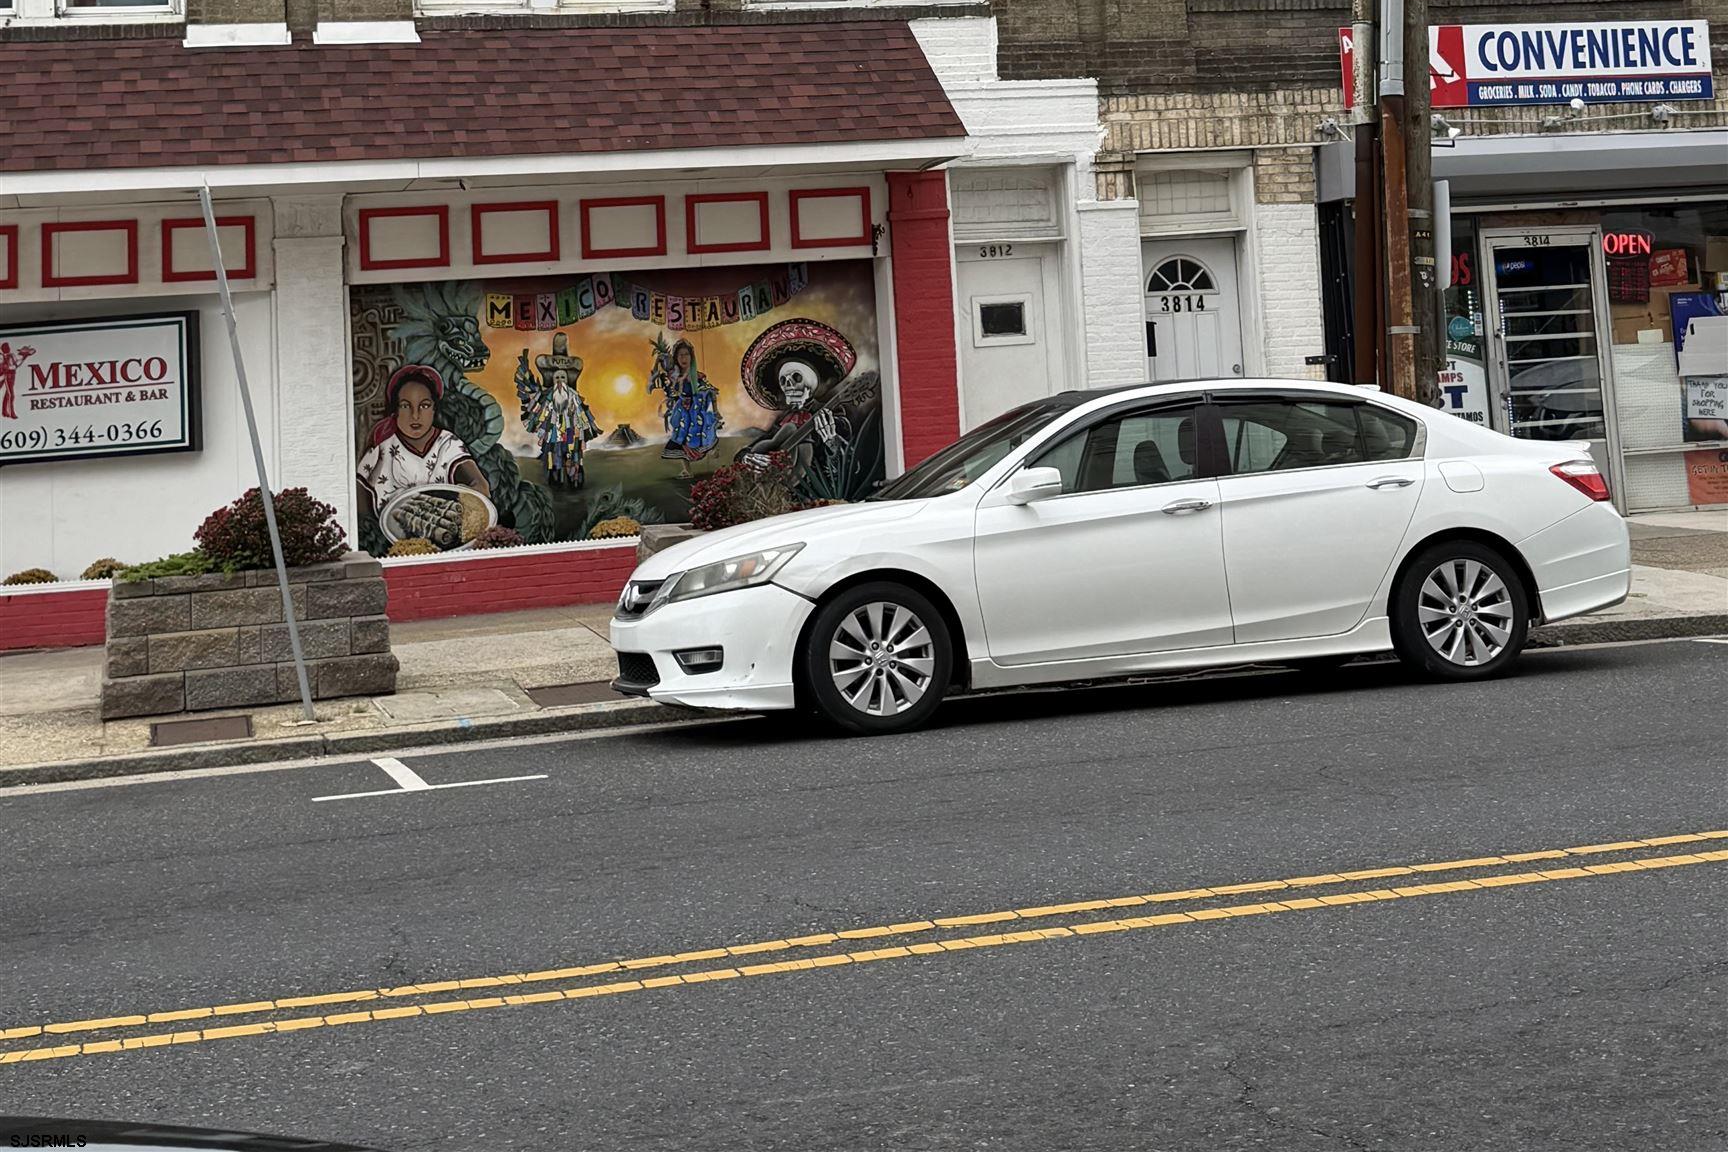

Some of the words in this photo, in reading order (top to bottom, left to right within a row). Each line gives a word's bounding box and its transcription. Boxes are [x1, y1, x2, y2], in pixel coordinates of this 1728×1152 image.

[1478, 26, 1697, 72] CONVENIENCE
[1478, 85, 1513, 100] GROCERIES
[1518, 84, 1535, 99] MILK
[1539, 84, 1557, 98] SODA
[1561, 83, 1583, 97] CANDY
[1587, 82, 1617, 97] TOBACCO
[1621, 81, 1643, 96] PHONE
[1644, 80, 1665, 95] CARDS
[1669, 79, 1702, 94] CHARGERS
[979, 244, 1013, 258] 3812
[1523, 235, 1551, 247] 3814
[1603, 232, 1651, 255] OPEN
[489, 280, 609, 322] MEXICO
[636, 263, 807, 323] RESTAURANT
[1160, 295, 1205, 313] 3814
[1453, 341, 1477, 354] STORE
[28, 356, 168, 392] MEXICO
[30, 391, 122, 411] RESTAURANT
[125, 392, 136, 403] &
[139, 388, 169, 401] BAR
[1700, 389, 1715, 398] FOR
[54, 419, 163, 447] 344-0366
